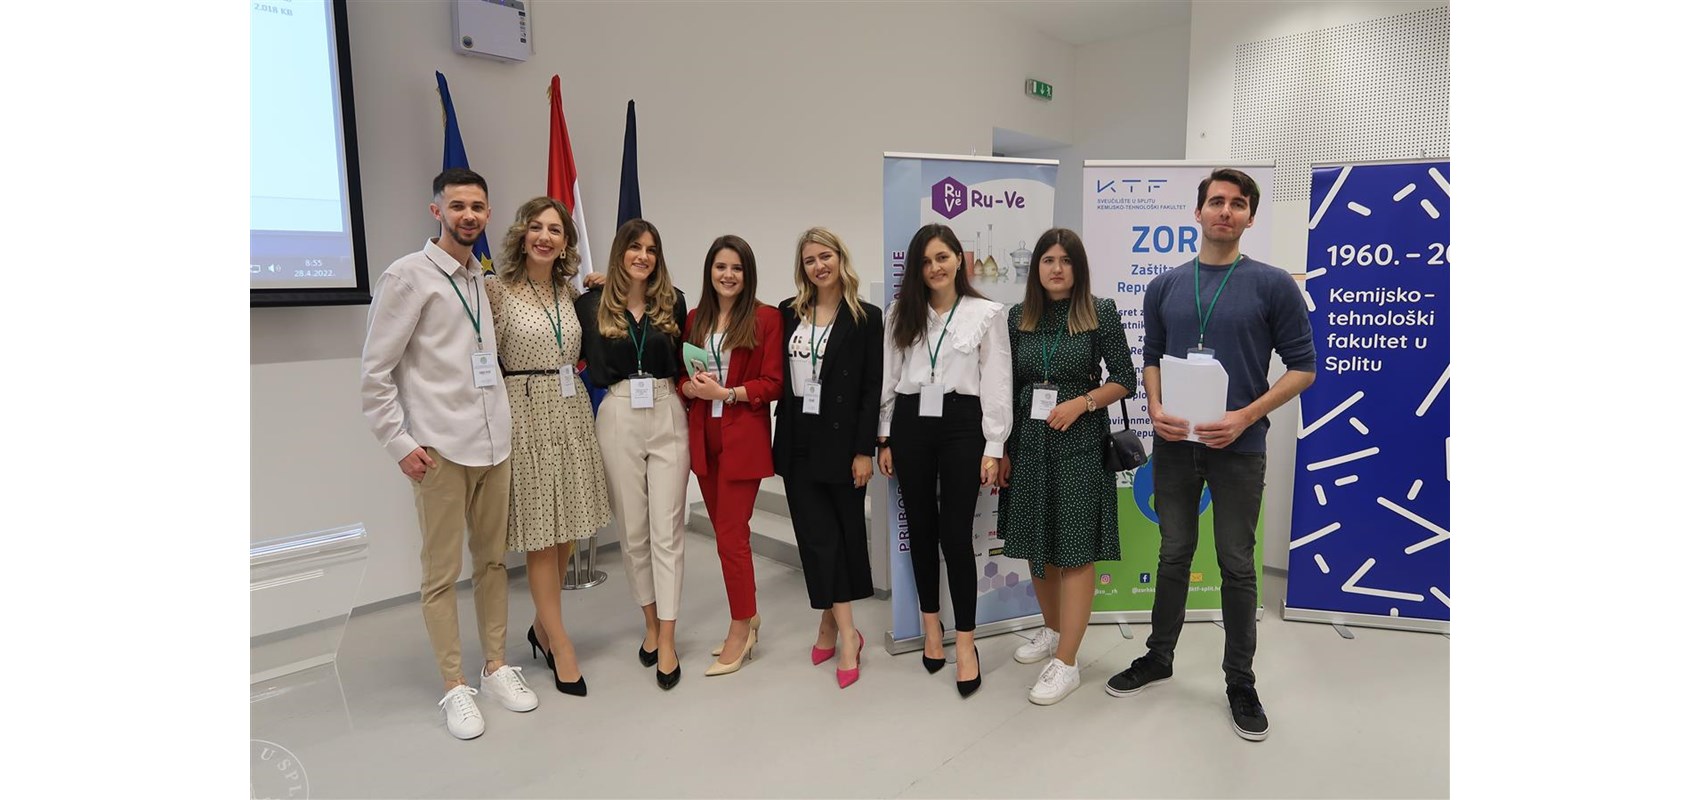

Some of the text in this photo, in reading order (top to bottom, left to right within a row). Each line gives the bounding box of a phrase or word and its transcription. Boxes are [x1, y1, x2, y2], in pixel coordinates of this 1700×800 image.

[944, 183, 961, 198] Ru
[1097, 179, 1168, 193] KTF
[944, 199, 962, 212] Ve
[971, 190, 1025, 208] Ru-Ve
[1327, 244, 1400, 266] 1960.
[1427, 243, 1450, 265] 2
[1131, 263, 1175, 275] Zaštit
[1328, 310, 1434, 326] tehnološki
[1327, 332, 1427, 349] fakultet u
[1325, 355, 1382, 374] Splitu
